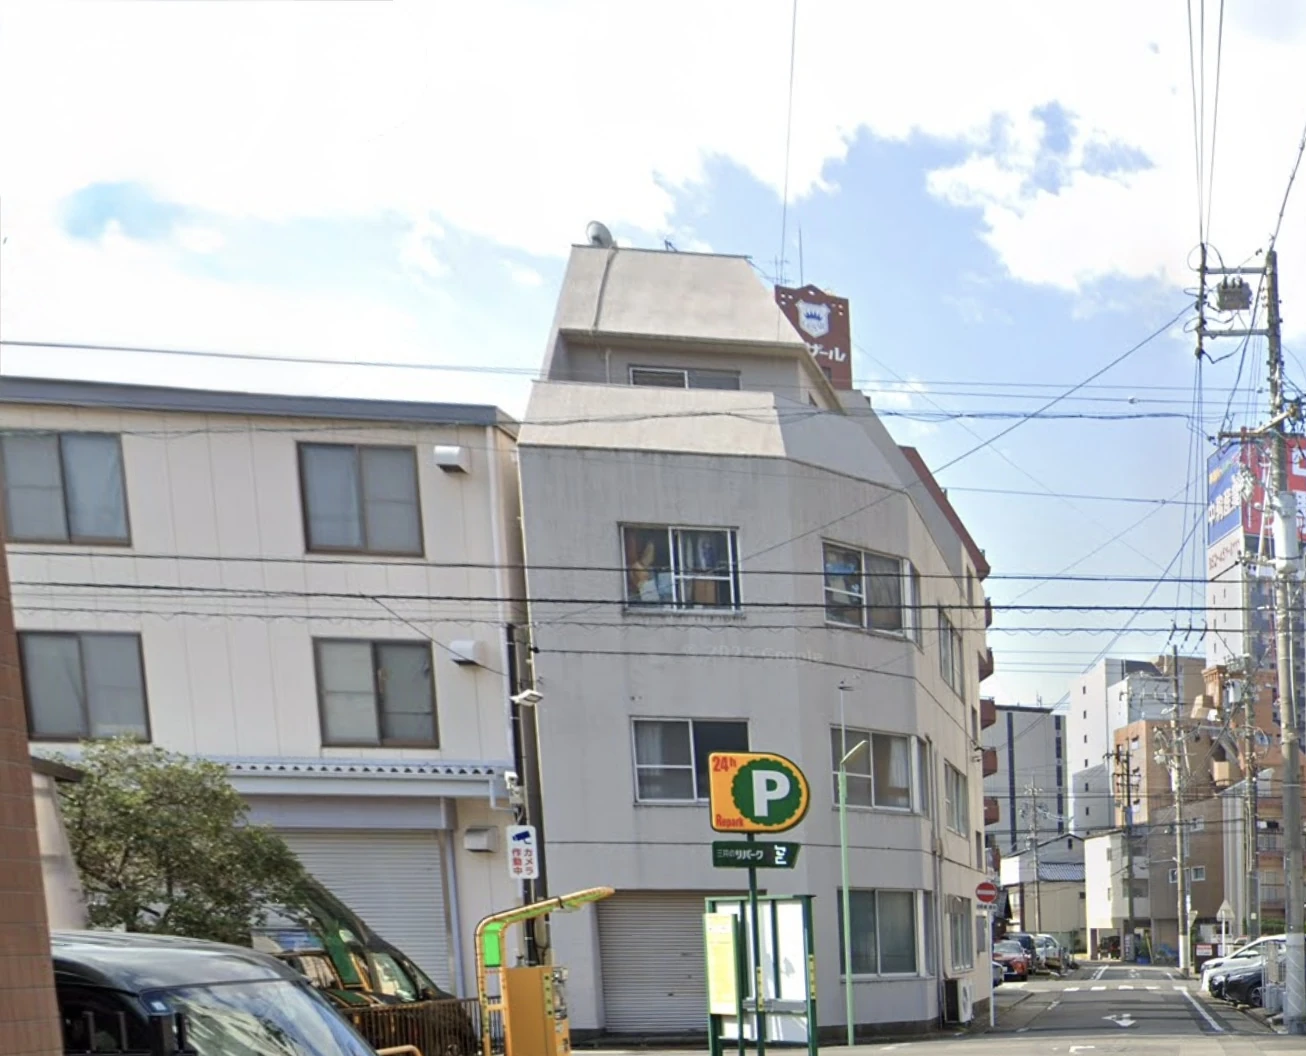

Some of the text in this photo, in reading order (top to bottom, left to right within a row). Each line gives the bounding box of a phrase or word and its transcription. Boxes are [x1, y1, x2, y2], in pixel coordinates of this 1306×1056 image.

[712, 755, 737, 773] 24h
[751, 769, 791, 817] P
[715, 813, 745, 829] Repark
[524, 848, 534, 876] カメラ
[716, 848, 765, 860] 三井のリパーク
